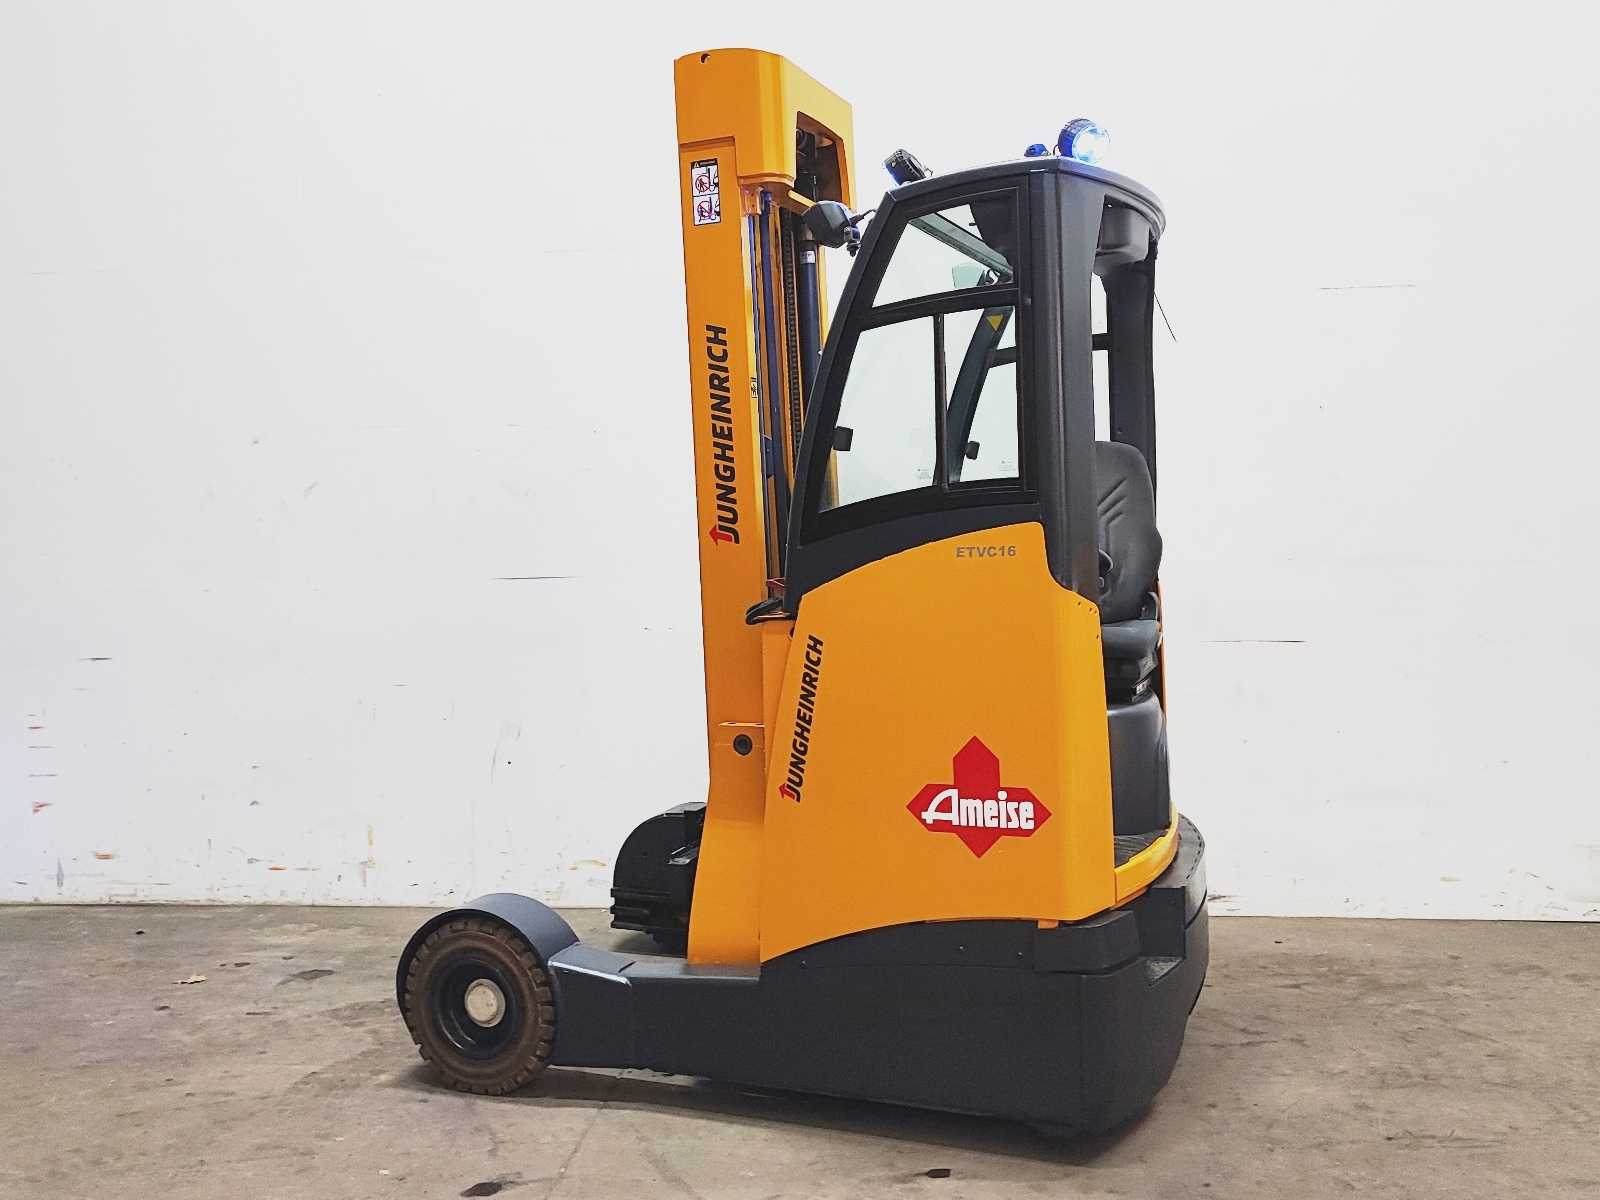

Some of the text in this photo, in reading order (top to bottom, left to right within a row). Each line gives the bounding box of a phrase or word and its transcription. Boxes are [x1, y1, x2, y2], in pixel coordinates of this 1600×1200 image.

[706, 324, 740, 545] JUNGHEINRICH
[956, 545, 1017, 558] ETVC16
[779, 634, 824, 803] JUNGHEINRICH
[921, 788, 1035, 830] Ameise
